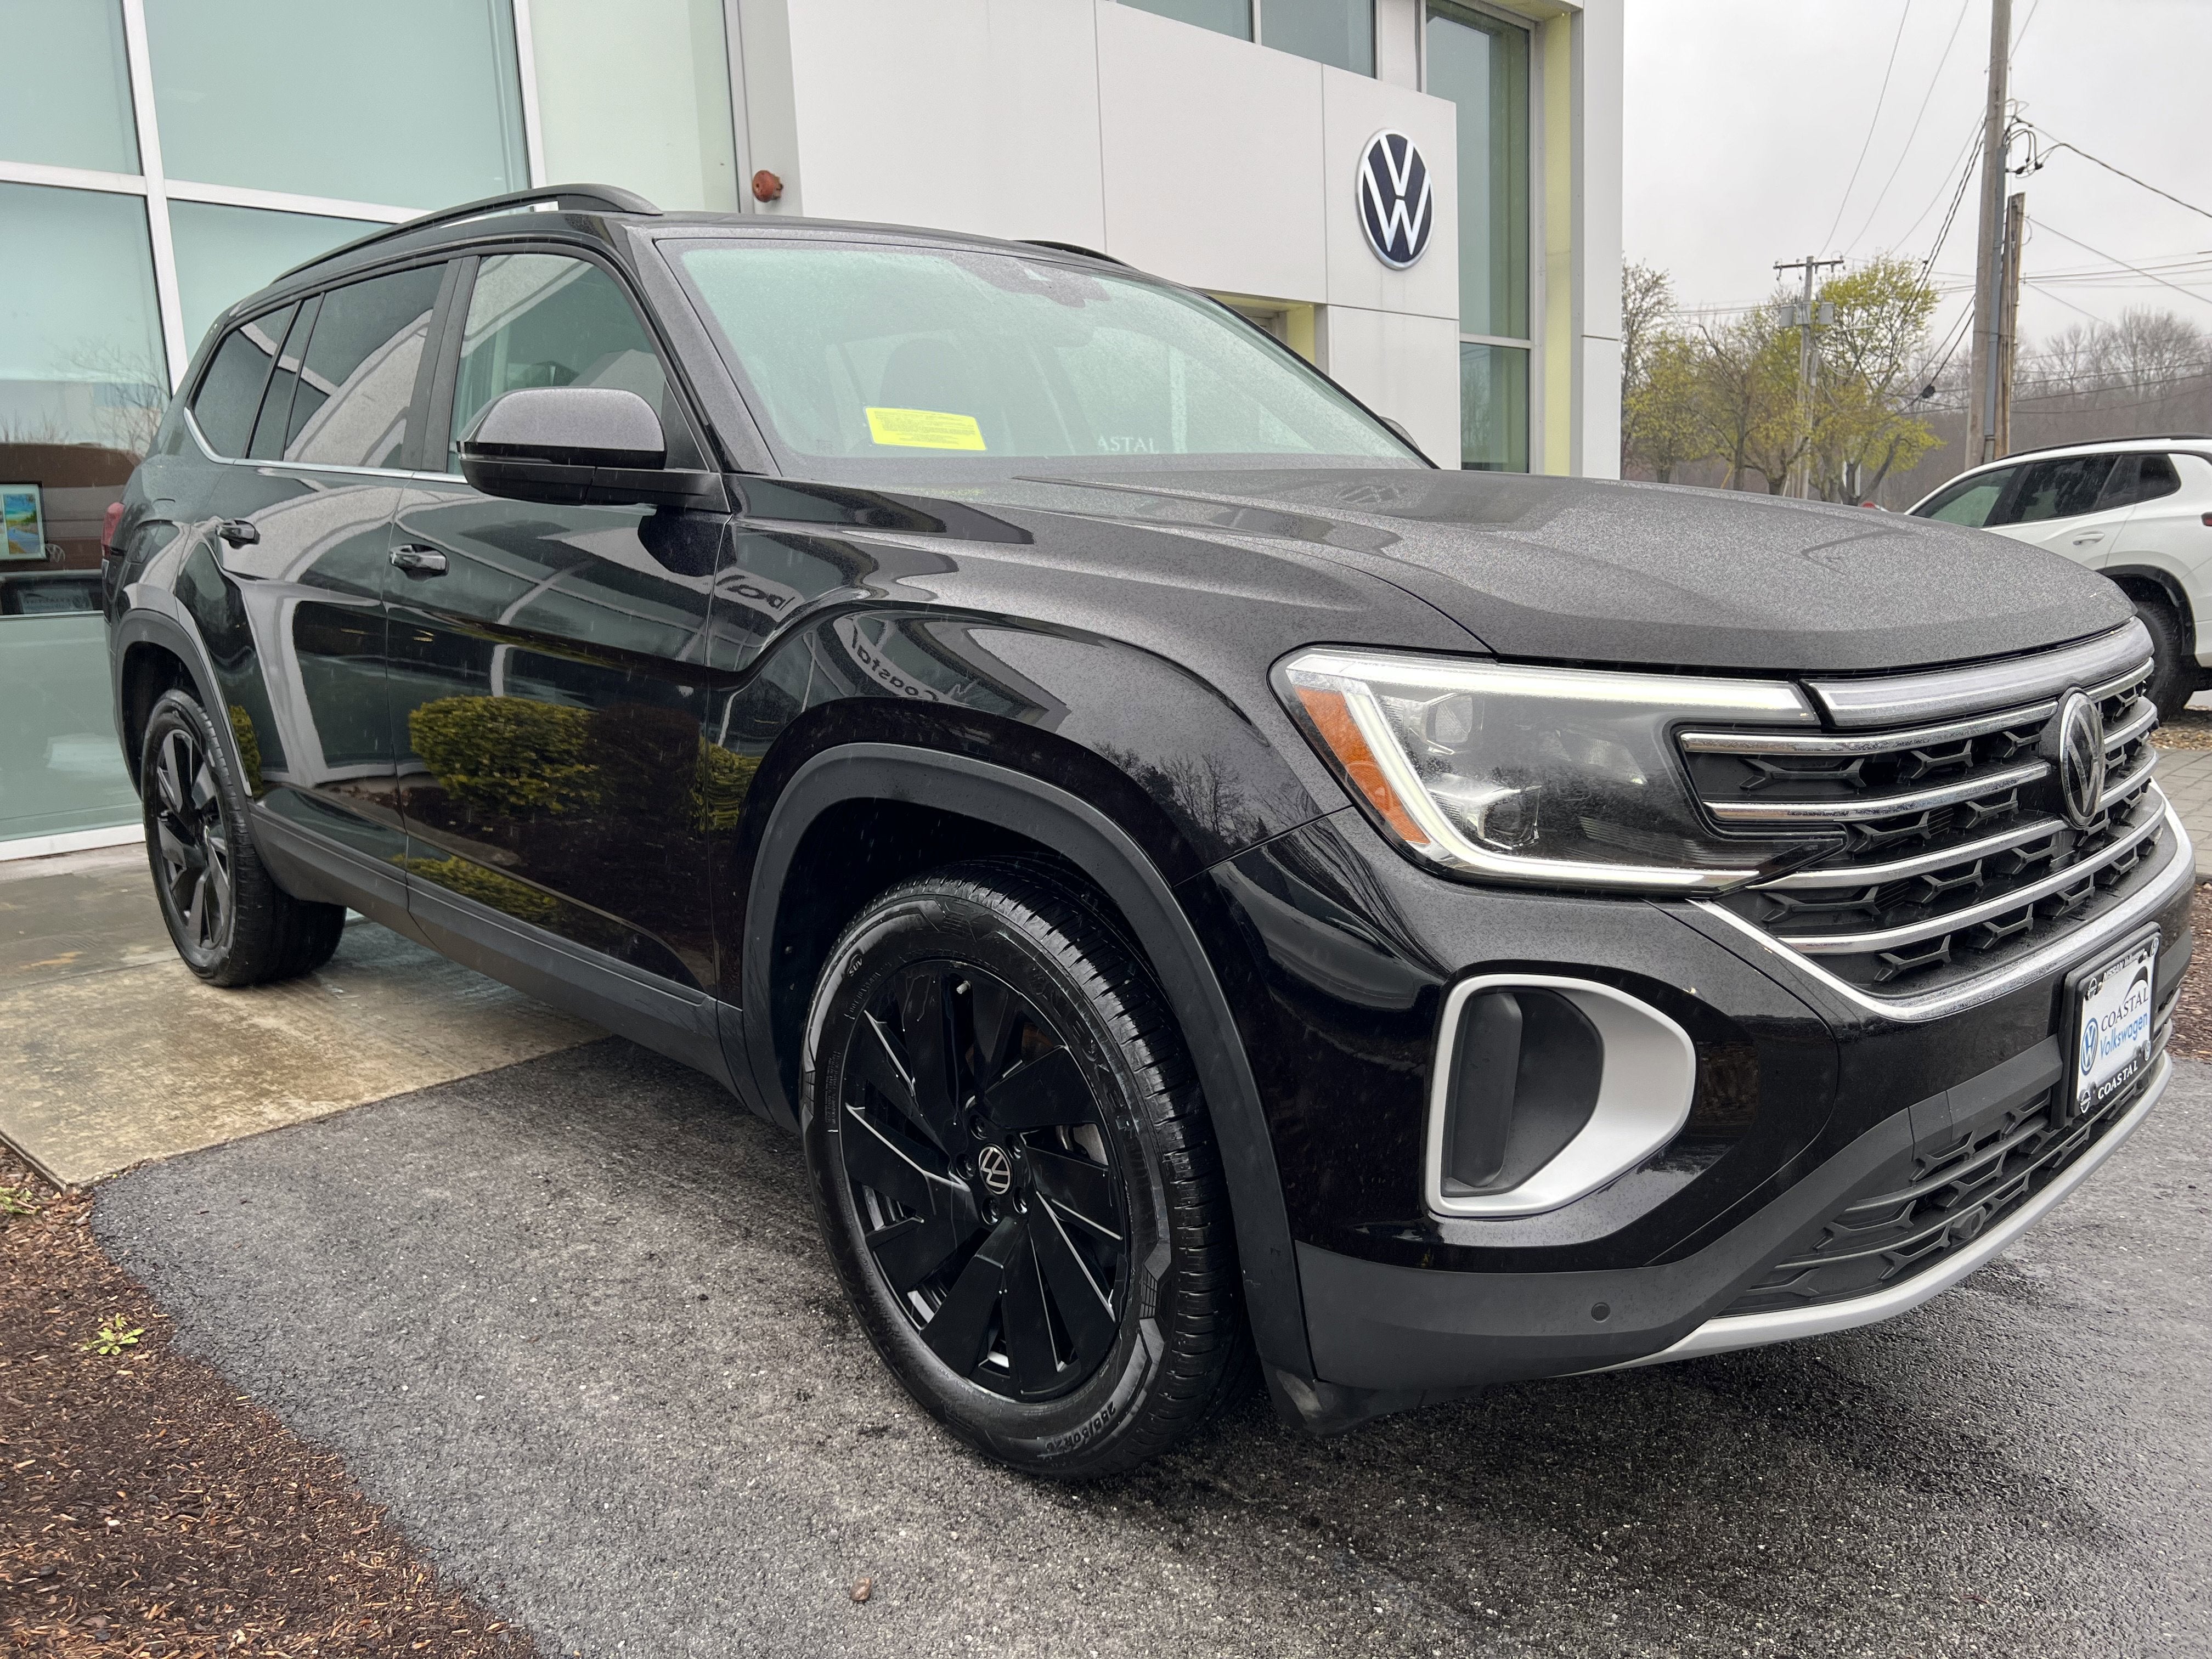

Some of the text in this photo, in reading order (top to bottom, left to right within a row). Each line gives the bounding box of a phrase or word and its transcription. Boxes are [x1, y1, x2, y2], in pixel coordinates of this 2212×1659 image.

[1097, 436, 1160, 454] ASTAL
[849, 957, 863, 977] SUV
[2101, 987, 2149, 1032] COASTAL
[2100, 1013, 2147, 1058] Volkswagen
[2097, 1062, 2138, 1099] COASTAL
